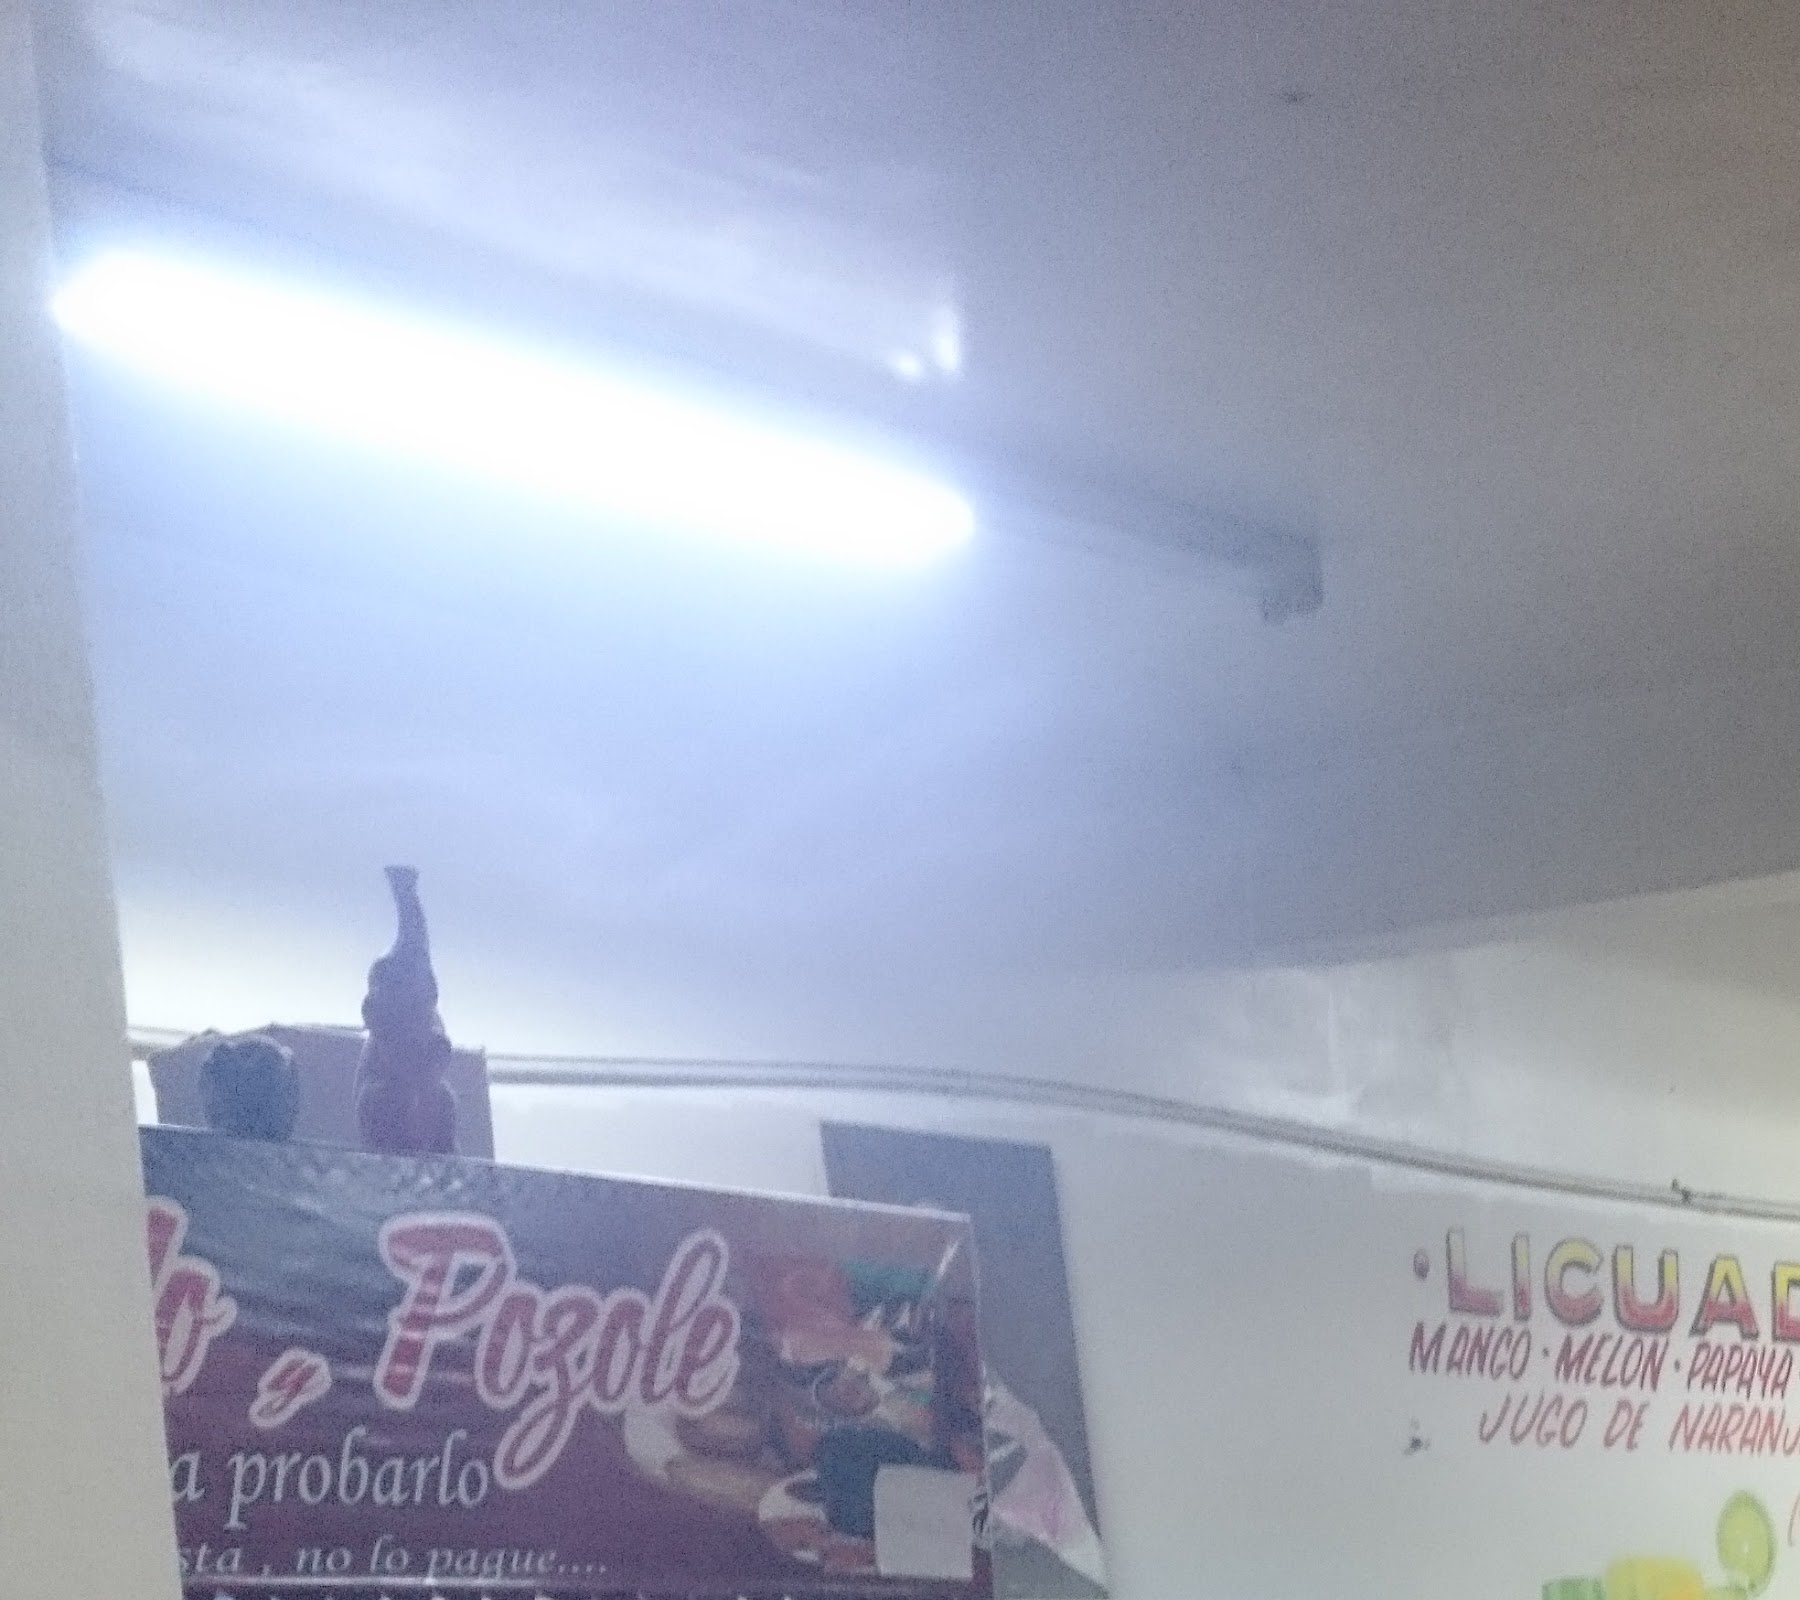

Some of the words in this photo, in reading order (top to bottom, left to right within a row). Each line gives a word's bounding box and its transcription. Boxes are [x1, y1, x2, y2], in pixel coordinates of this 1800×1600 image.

[250, 1349, 332, 1428] y
[376, 1211, 741, 1489] Pozole
[1408, 1320, 1533, 1381] MANGO
[1555, 1333, 1668, 1392] MELON
[1686, 1340, 1794, 1401] PAPAYA
[1478, 1389, 1588, 1449] JUGO
[1602, 1399, 1648, 1451] DE
[223, 1426, 488, 1530] probarlo
[297, 1549, 352, 1574] no
[369, 1533, 409, 1574] lo
